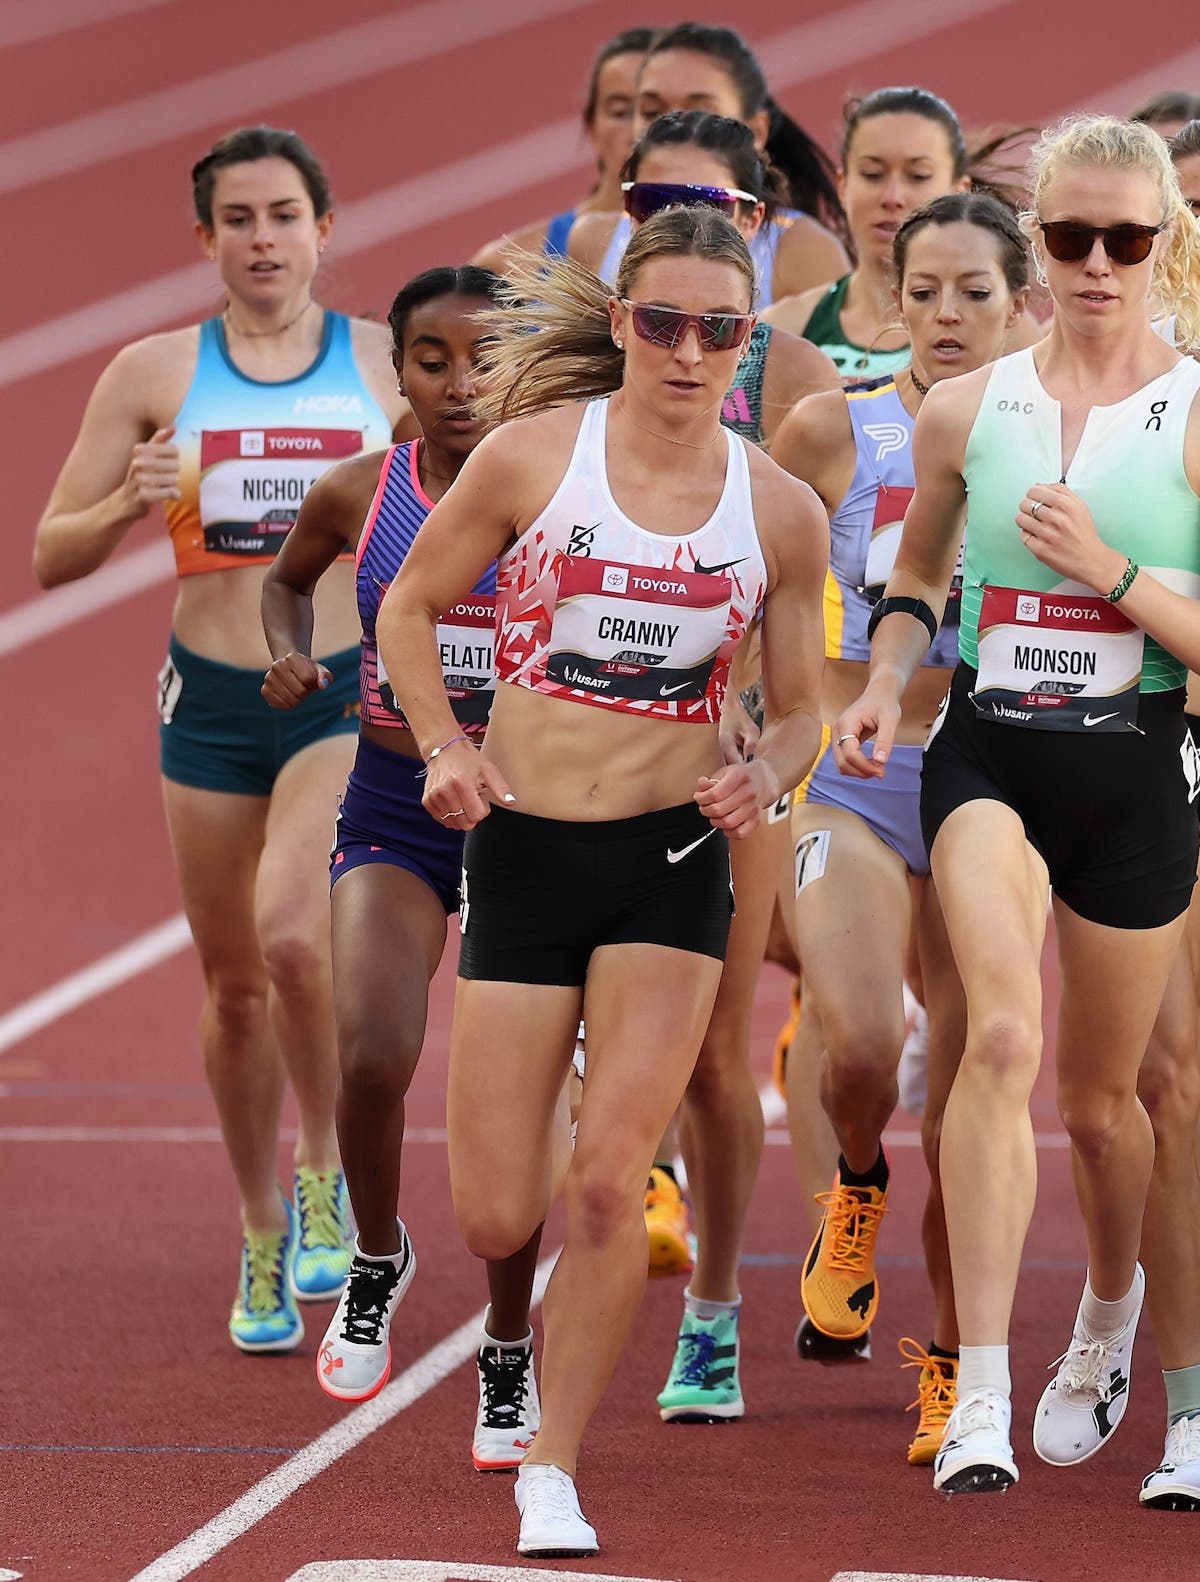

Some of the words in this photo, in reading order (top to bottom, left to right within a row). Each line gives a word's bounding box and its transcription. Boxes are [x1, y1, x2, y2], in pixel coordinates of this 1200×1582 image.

[293, 396, 362, 413] HOKA
[997, 400, 1034, 415] OAC
[268, 437, 323, 451] TOYOTA
[243, 478, 316, 501] NICHOL
[632, 576, 688, 594] TOYOTA
[1044, 604, 1101, 620] TOYOTA
[598, 616, 679, 647] CRANNY
[439, 643, 492, 670] ELATI
[1014, 645, 1096, 676] MONSON
[577, 674, 611, 689] USATF
[1004, 708, 1034, 721] USATF
[796, 835, 819, 888] 7
